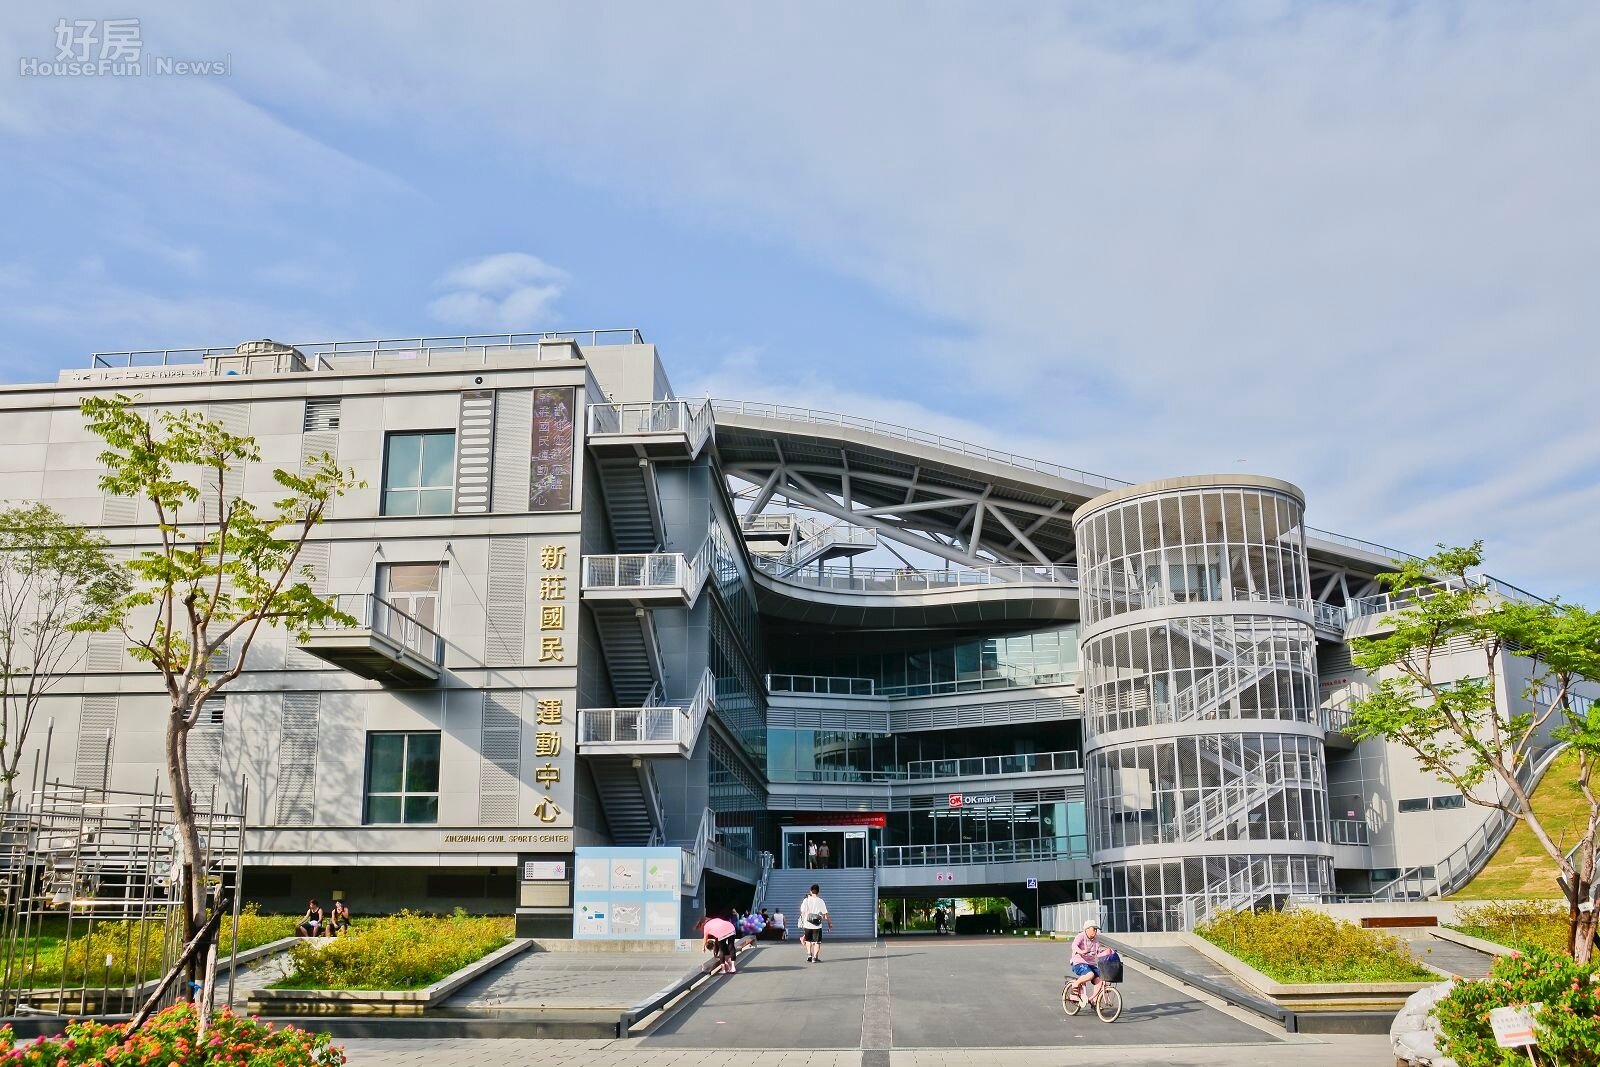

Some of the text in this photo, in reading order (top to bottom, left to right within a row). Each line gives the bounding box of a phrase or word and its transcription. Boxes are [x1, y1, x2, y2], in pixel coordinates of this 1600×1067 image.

[533, 545, 566, 823] 新莊國民 運動中心
[444, 834, 569, 843] XINZHUANG CIVIL SPORTS CENTER
